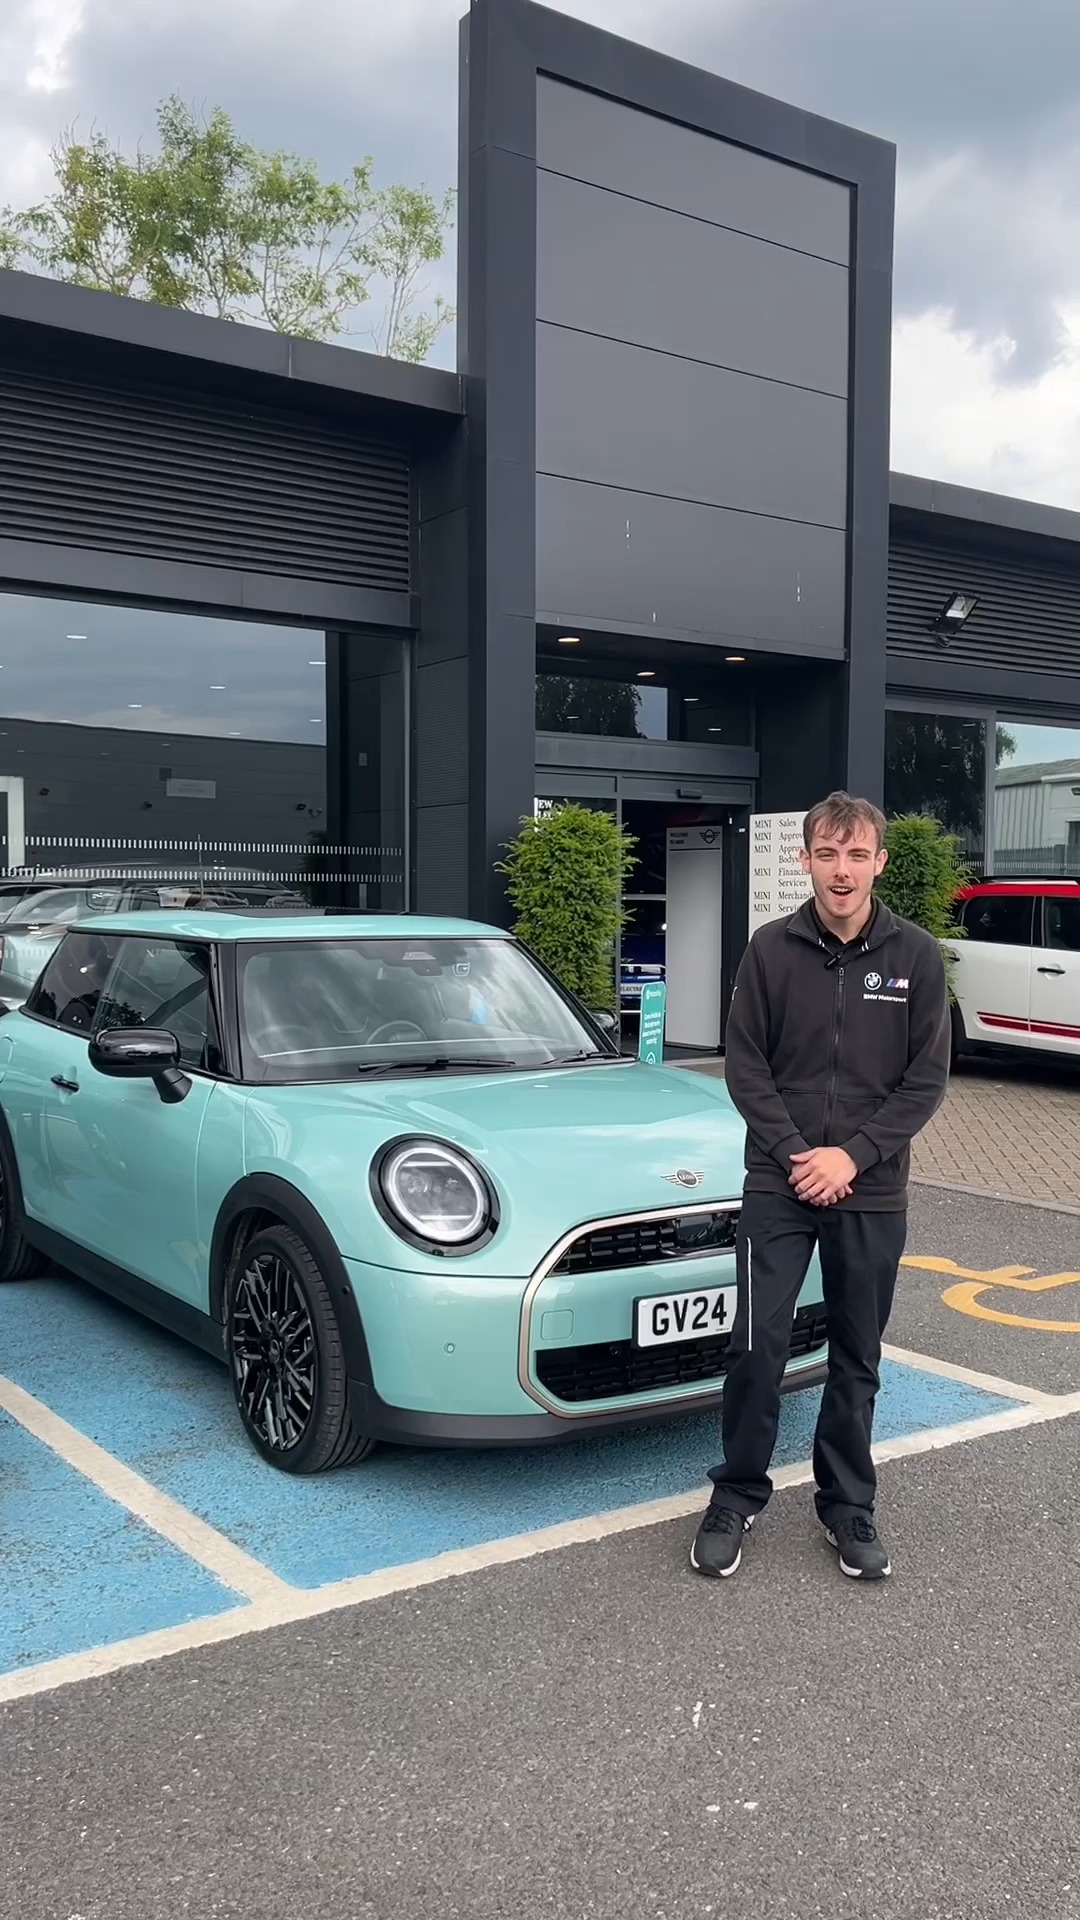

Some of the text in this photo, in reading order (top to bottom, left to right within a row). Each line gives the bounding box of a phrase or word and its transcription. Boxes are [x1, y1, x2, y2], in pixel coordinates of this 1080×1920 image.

[754, 818, 797, 829] MINI Sales
[754, 832, 803, 842] MINI Approv
[754, 845, 772, 853] MINI
[754, 868, 771, 876] MINI
[778, 879, 807, 888] Services
[754, 891, 771, 900] MINI
[754, 904, 771, 912] MINI
[878, 994, 907, 1002] Motorsport
[652, 1293, 727, 1336] GV24
